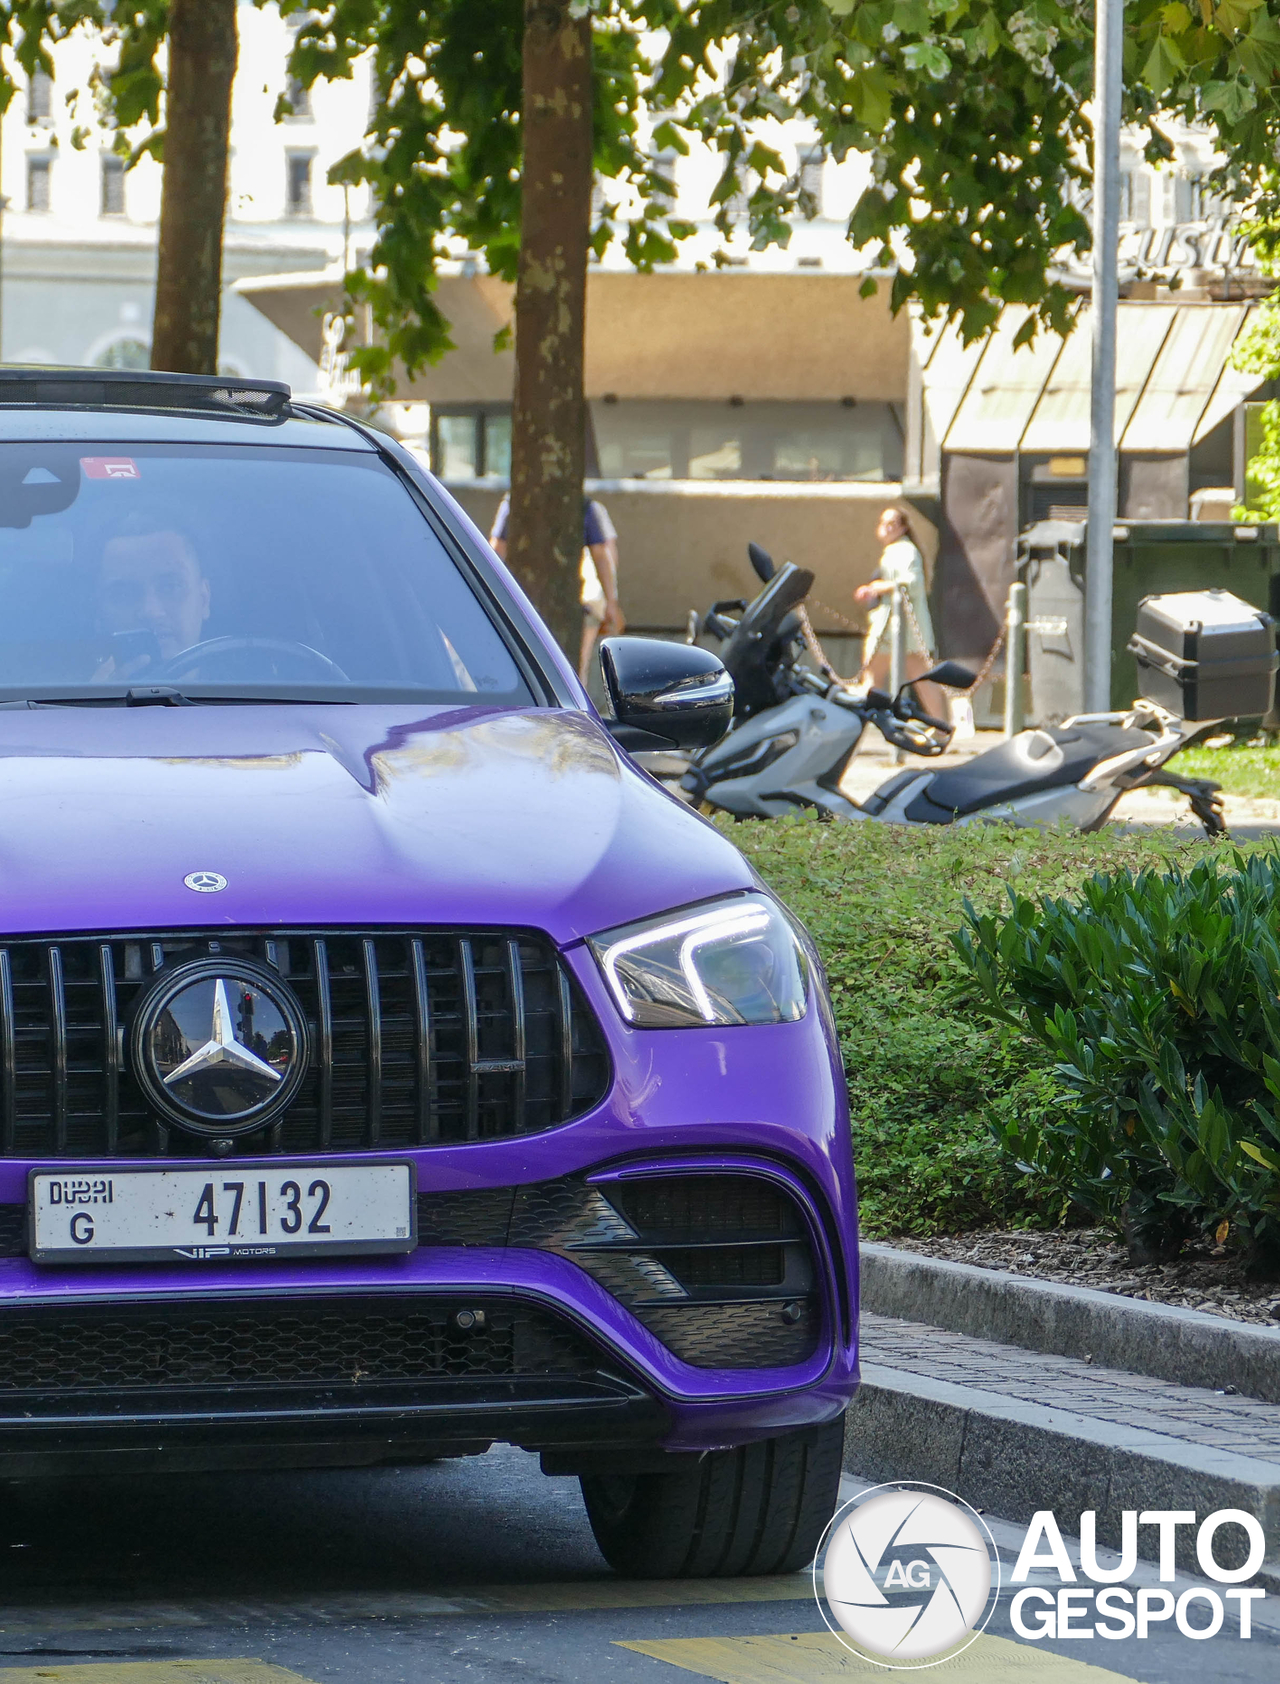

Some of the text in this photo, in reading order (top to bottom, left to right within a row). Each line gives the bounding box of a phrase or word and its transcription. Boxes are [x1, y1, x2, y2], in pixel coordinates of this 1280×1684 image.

[193, 1179, 331, 1237] 47132
[69, 1211, 95, 1245] G
[173, 1247, 276, 1259] VIP MOTORS
